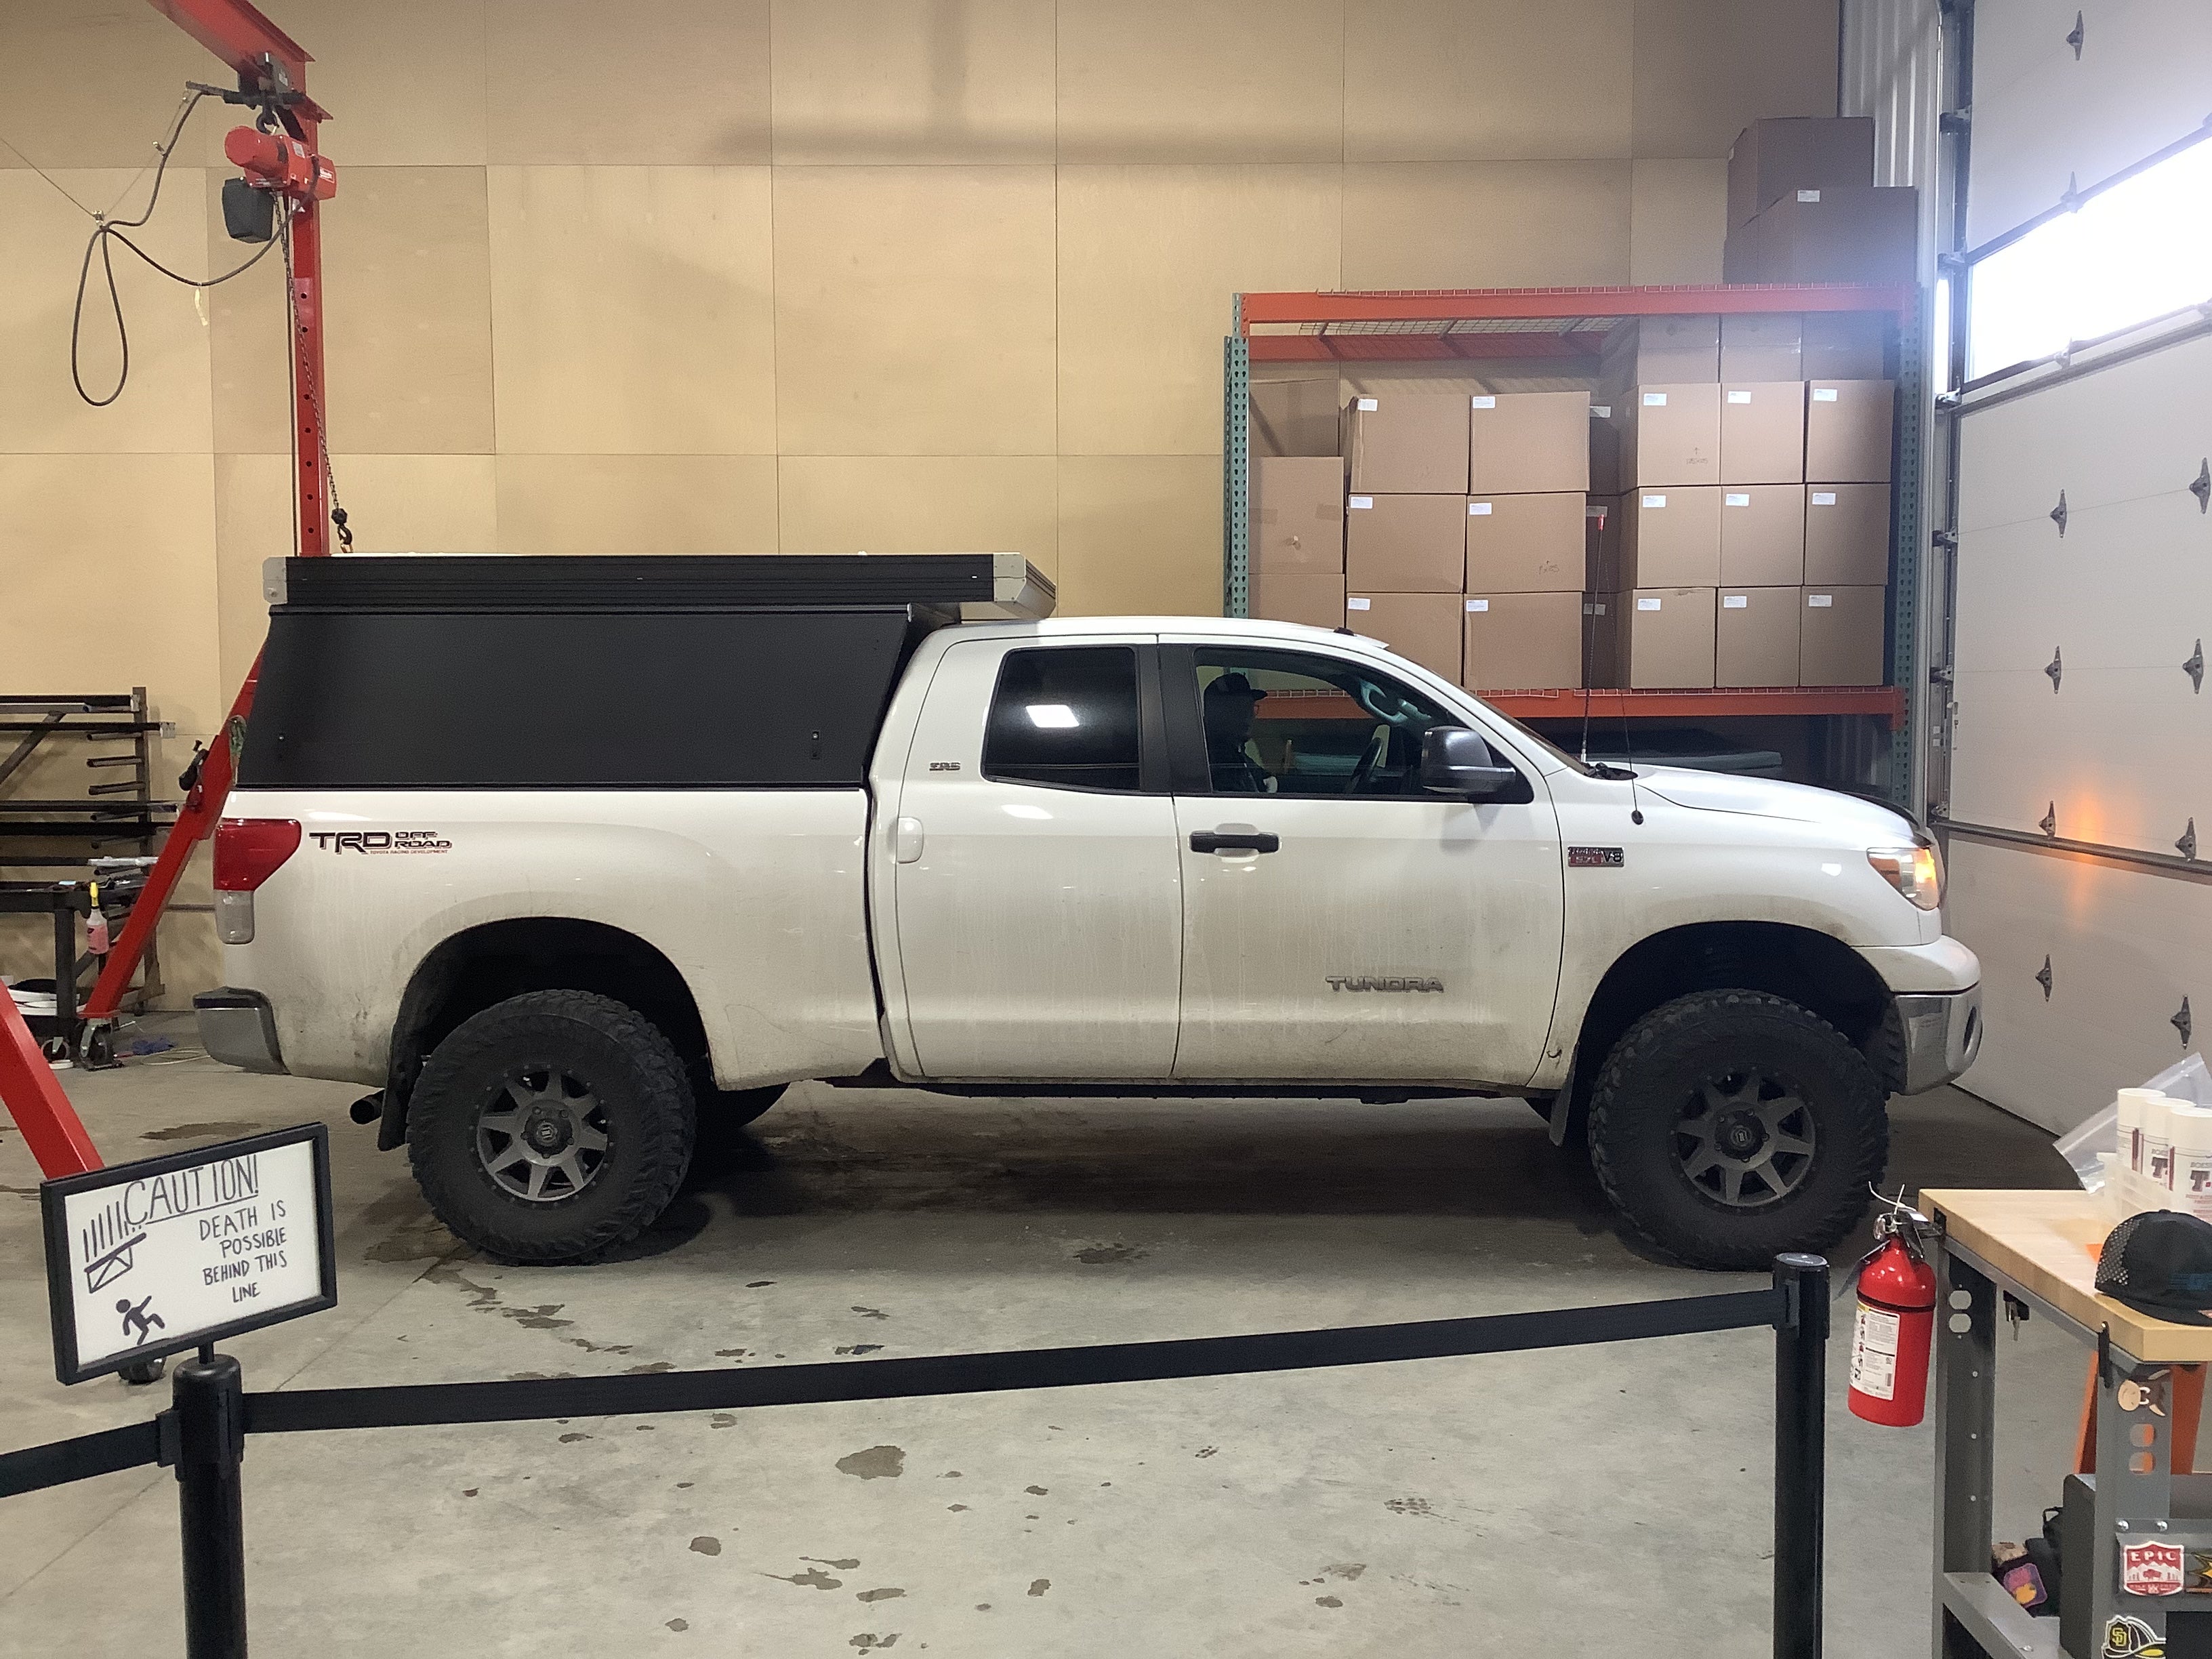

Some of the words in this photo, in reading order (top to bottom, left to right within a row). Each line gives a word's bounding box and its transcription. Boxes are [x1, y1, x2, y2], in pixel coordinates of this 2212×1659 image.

[309, 832, 391, 855] TRD
[394, 840, 452, 848] ROAD
[1601, 851, 1623, 863] V8
[1326, 976, 1444, 994] TUNDRA
[123, 1153, 259, 1225] CAUTION!
[199, 1206, 258, 1241] DEATH
[271, 1200, 287, 1221] IS
[220, 1227, 287, 1258] POSSIBLE
[203, 1260, 250, 1286] BEHIND
[254, 1250, 288, 1273] THIS
[232, 1282, 261, 1304] LINE
[2131, 1551, 2177, 1561] EPIC
